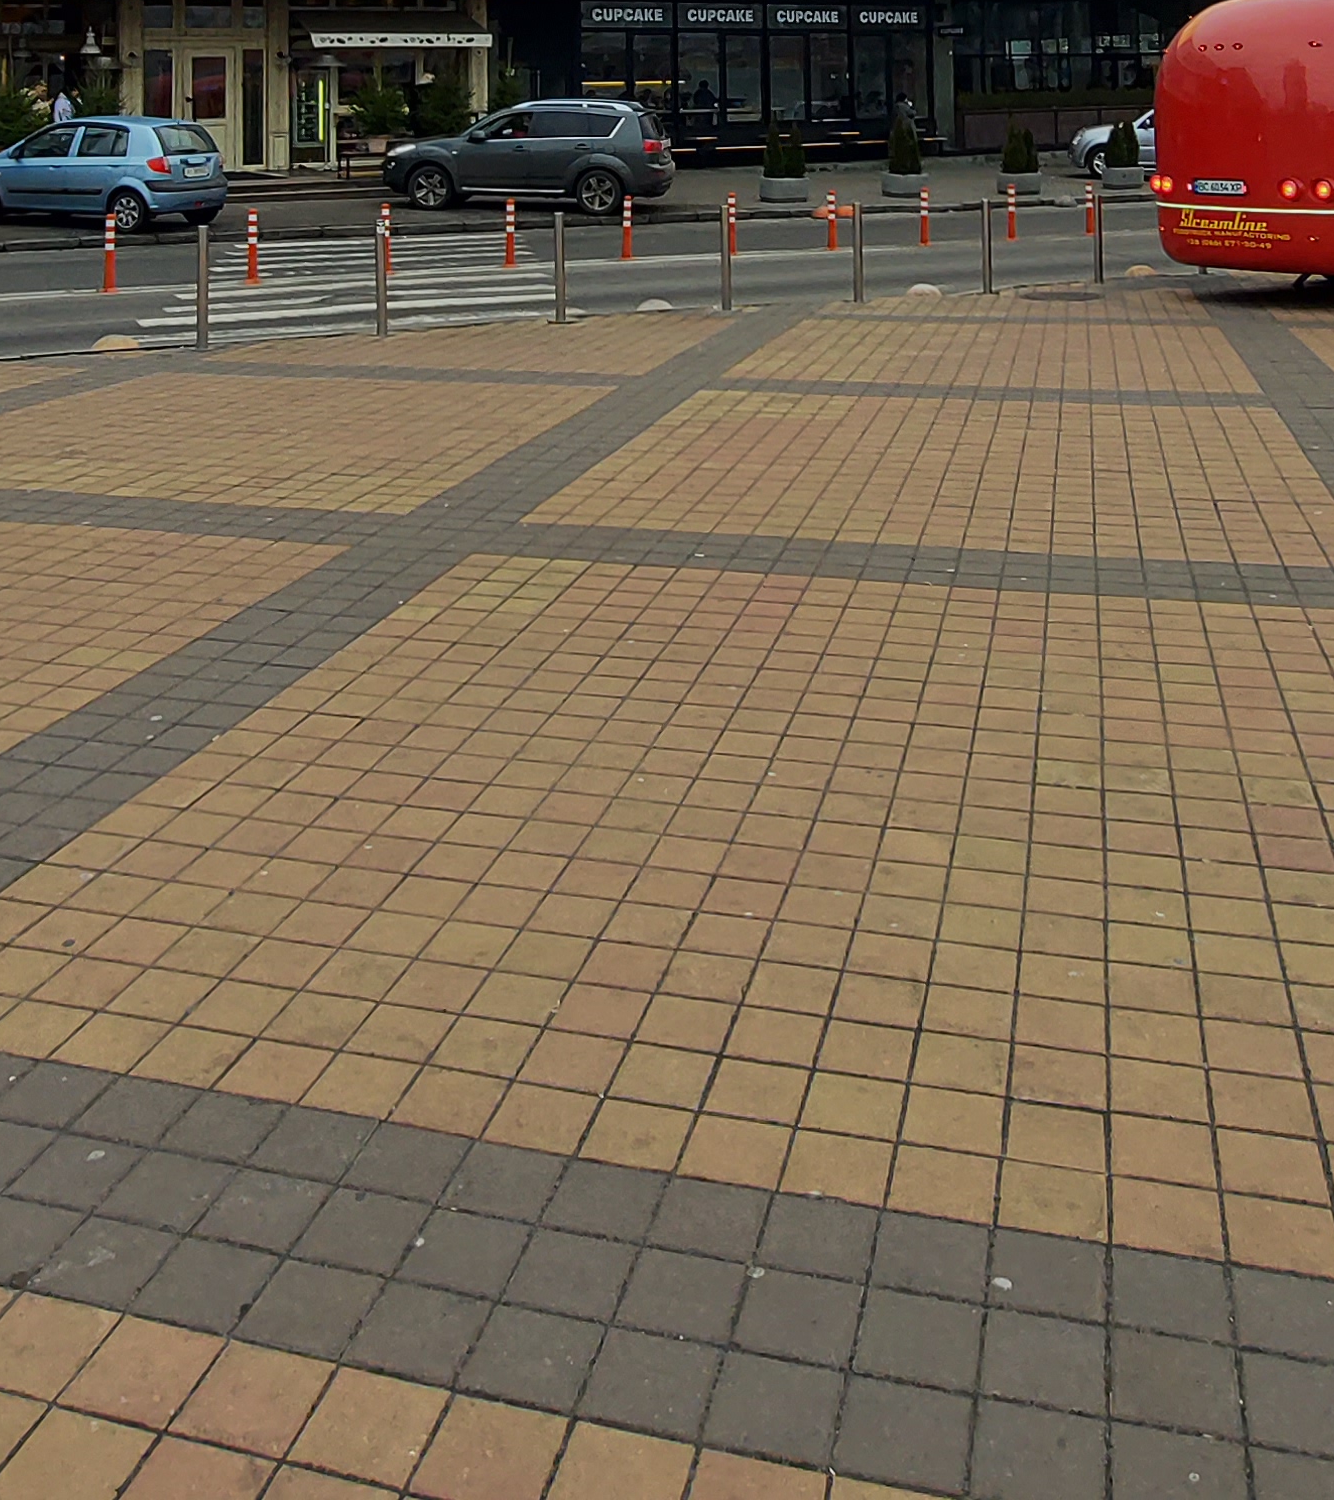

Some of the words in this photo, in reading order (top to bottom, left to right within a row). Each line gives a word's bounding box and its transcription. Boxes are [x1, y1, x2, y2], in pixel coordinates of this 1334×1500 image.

[591, 7, 664, 22] CUPCAKE
[687, 8, 754, 23] CUPCAKE
[776, 9, 840, 24] CUPCAKE
[859, 10, 919, 24] CUPCAKE
[1179, 208, 1269, 232] Streamline
